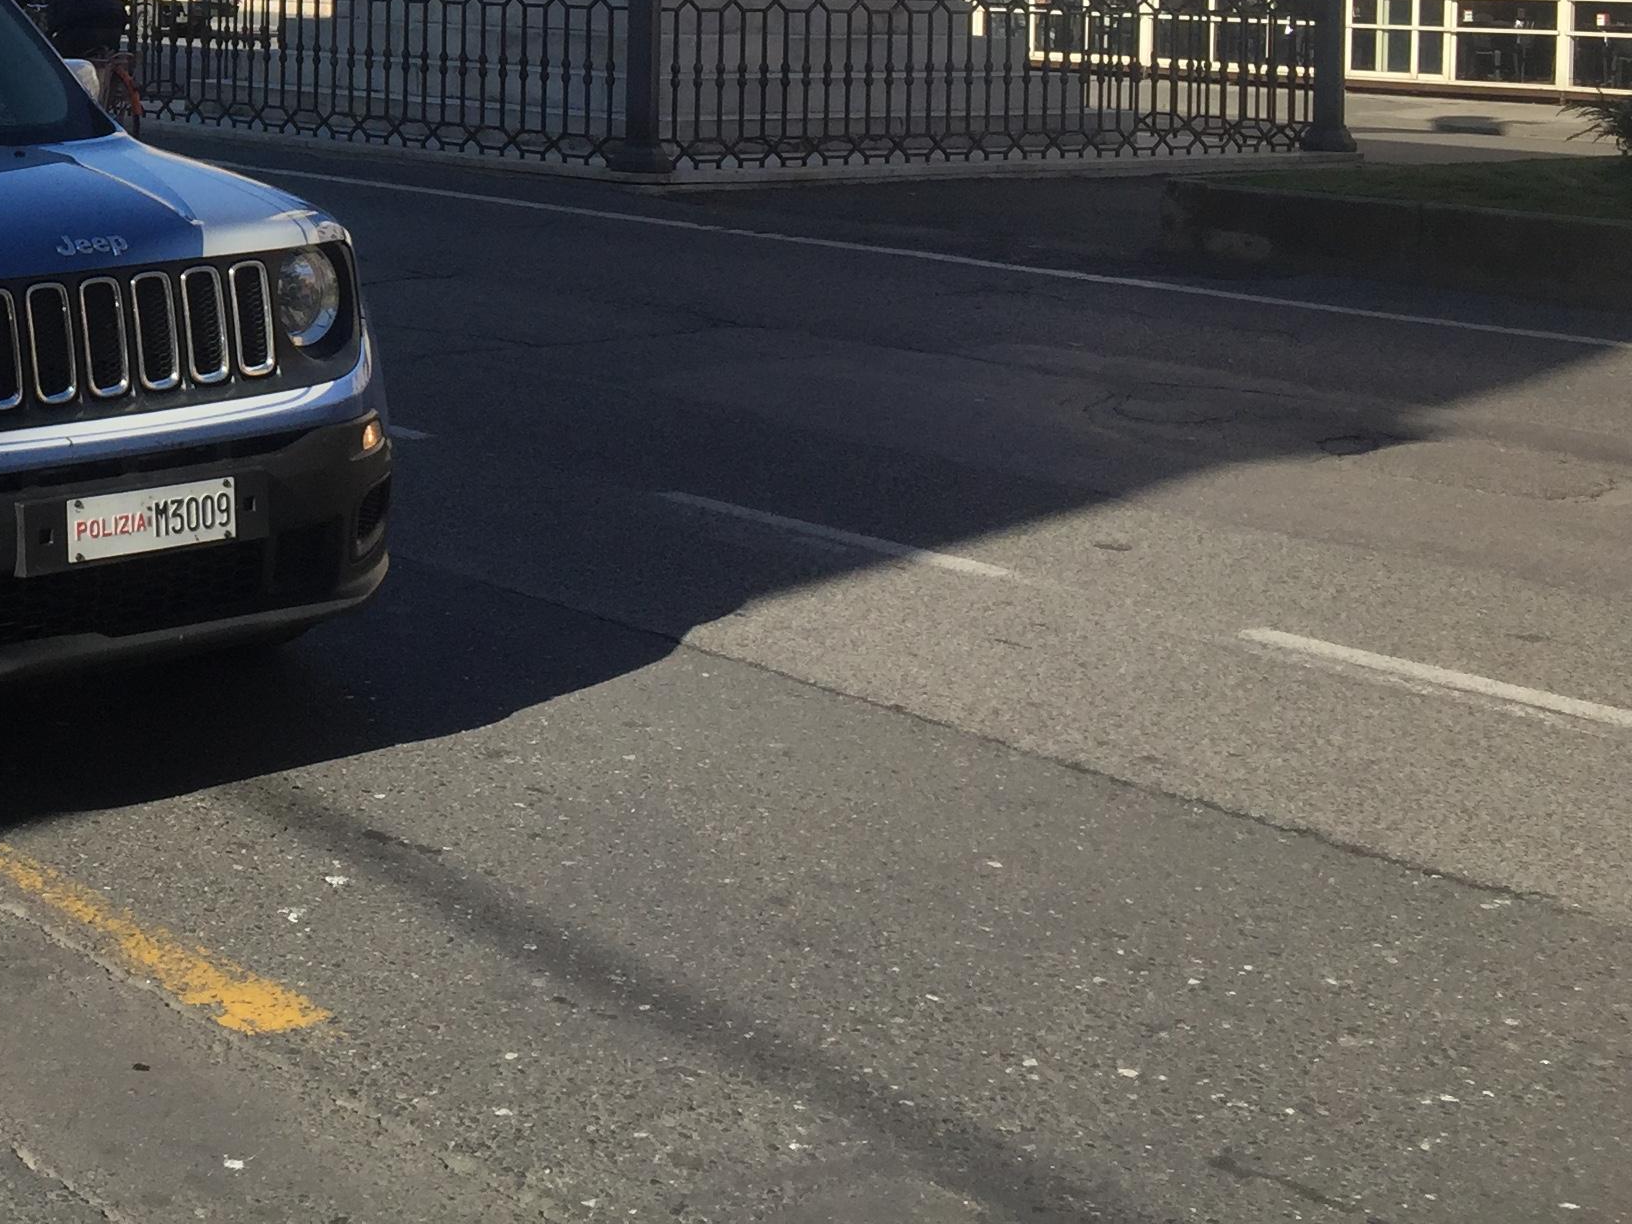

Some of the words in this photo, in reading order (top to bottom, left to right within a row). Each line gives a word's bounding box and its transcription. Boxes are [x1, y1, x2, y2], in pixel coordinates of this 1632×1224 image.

[56, 235, 128, 256] Jeep
[75, 512, 147, 542] POLIZIA
[154, 492, 231, 538] M3009
